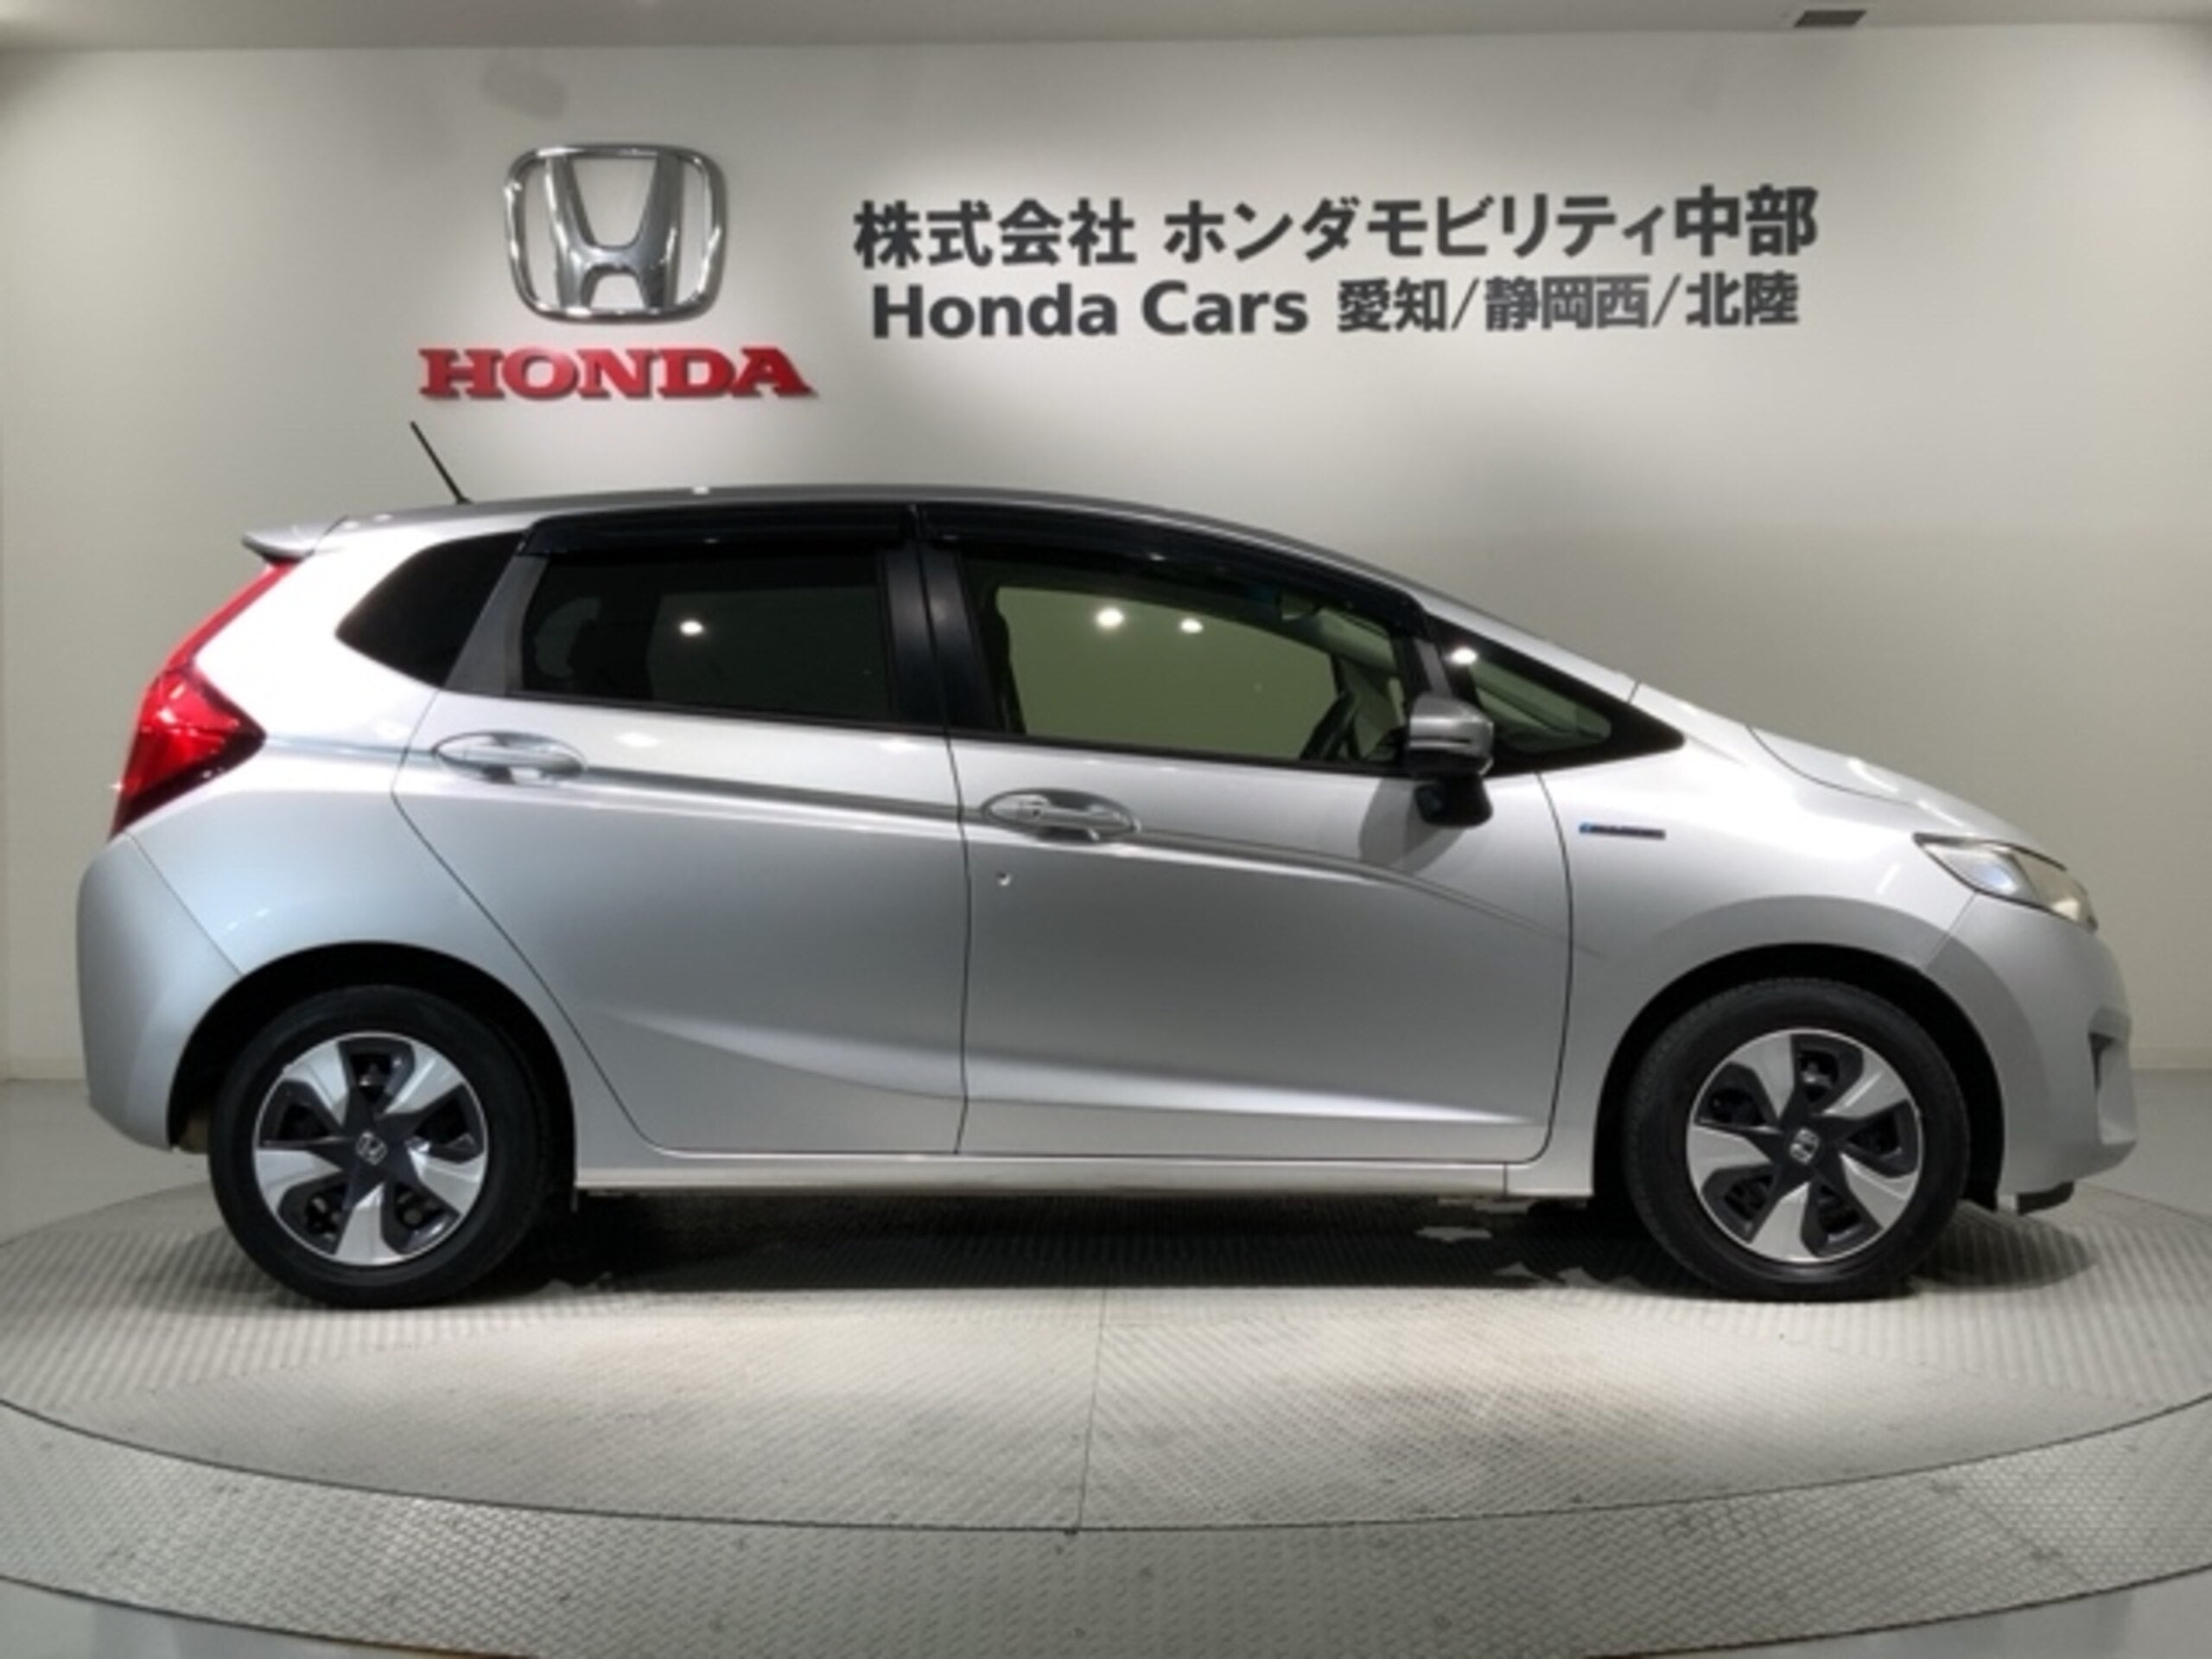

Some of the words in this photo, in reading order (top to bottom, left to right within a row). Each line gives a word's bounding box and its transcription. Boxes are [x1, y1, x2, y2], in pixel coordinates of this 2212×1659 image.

[851, 197, 1138, 270] 株式会社
[1162, 182, 1821, 265] ホンダモビリティ中部
[871, 282, 1118, 339] Honda
[1141, 279, 1309, 335] Cars
[1337, 270, 1801, 334] 愛知/静岡西/北陸
[419, 344, 813, 400] HONDA
